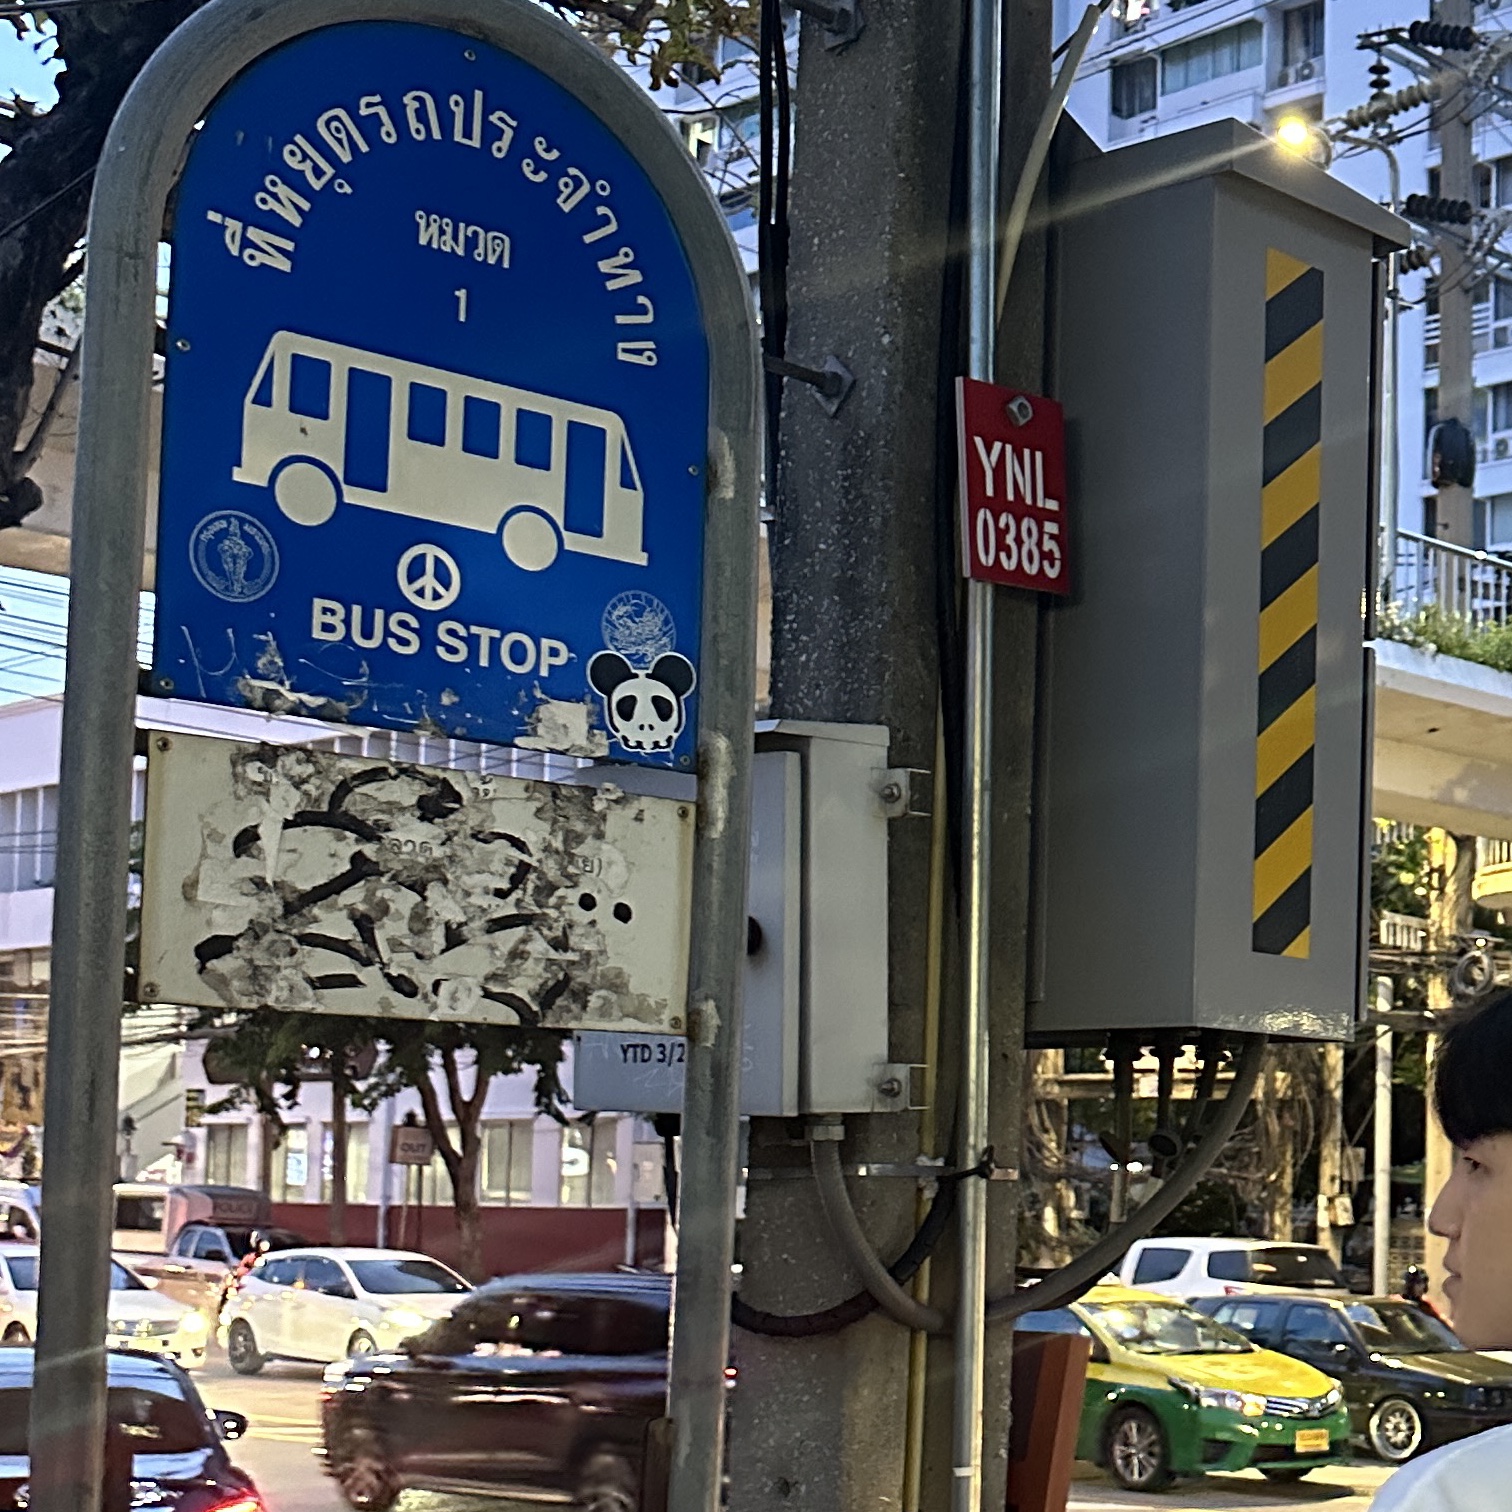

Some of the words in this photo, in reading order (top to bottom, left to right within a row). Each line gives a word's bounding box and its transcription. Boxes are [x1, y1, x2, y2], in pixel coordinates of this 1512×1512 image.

[207, 90, 658, 366] ที่หยุดรถประจำทาง
[415, 210, 510, 268] หมวด
[454, 288, 468, 322] 1
[973, 435, 1060, 511] YNL
[976, 507, 1062, 579] 0385
[311, 597, 421, 656] BUS
[436, 619, 570, 678] STOP
[620, 1043, 652, 1063] YTD
